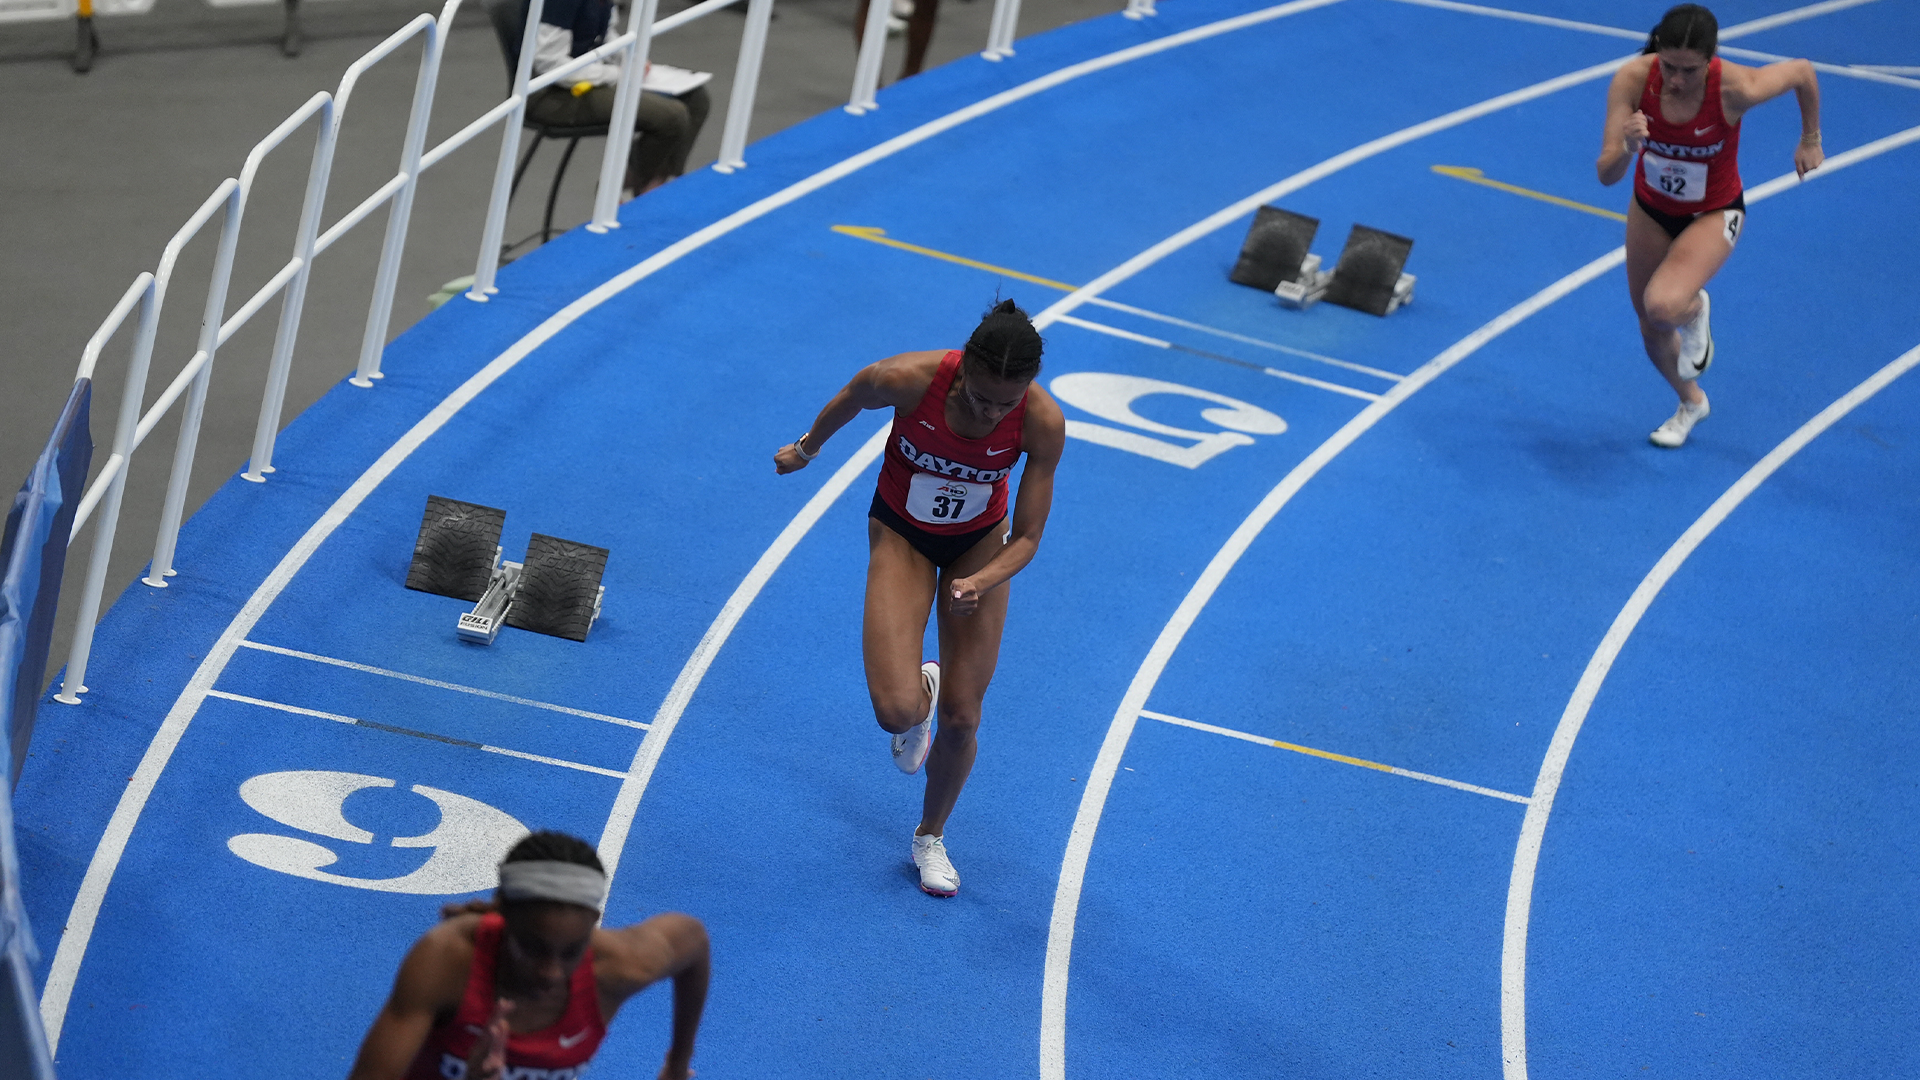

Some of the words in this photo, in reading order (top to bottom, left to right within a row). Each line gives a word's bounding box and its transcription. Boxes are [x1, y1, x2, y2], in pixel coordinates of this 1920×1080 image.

[1660, 175, 1686, 196] 52
[1728, 214, 1739, 239] 4
[1050, 372, 1287, 470] 5
[932, 495, 965, 519] 37
[462, 615, 490, 626] GILL
